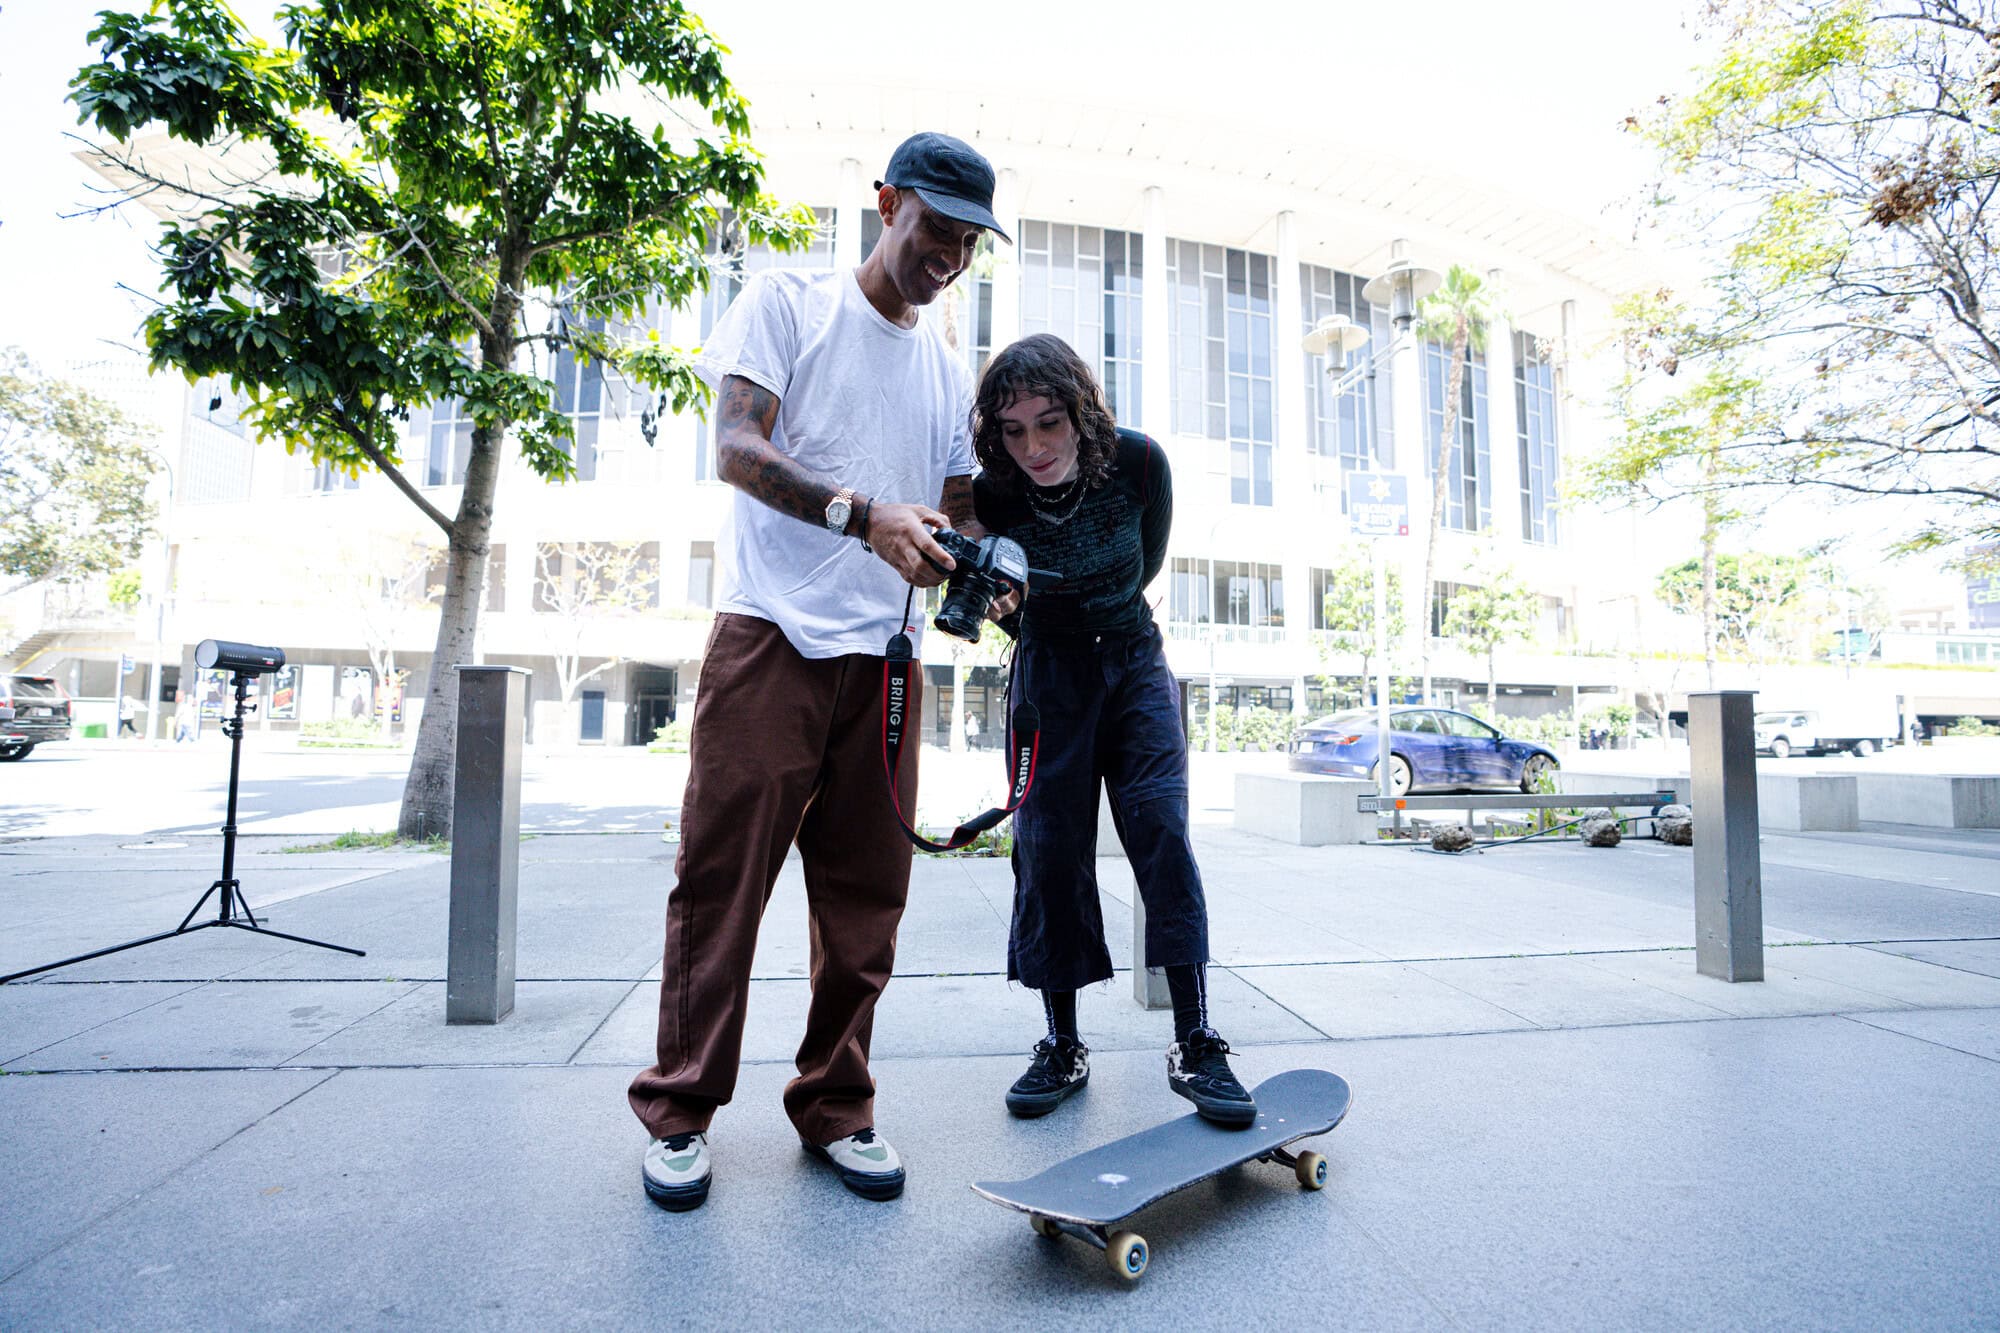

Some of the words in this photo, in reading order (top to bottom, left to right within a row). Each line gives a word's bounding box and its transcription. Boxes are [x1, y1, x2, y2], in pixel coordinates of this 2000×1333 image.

[890, 677, 904, 726] BRING
[888, 732, 900, 745] IT
[1015, 747, 1031, 798] Canon
